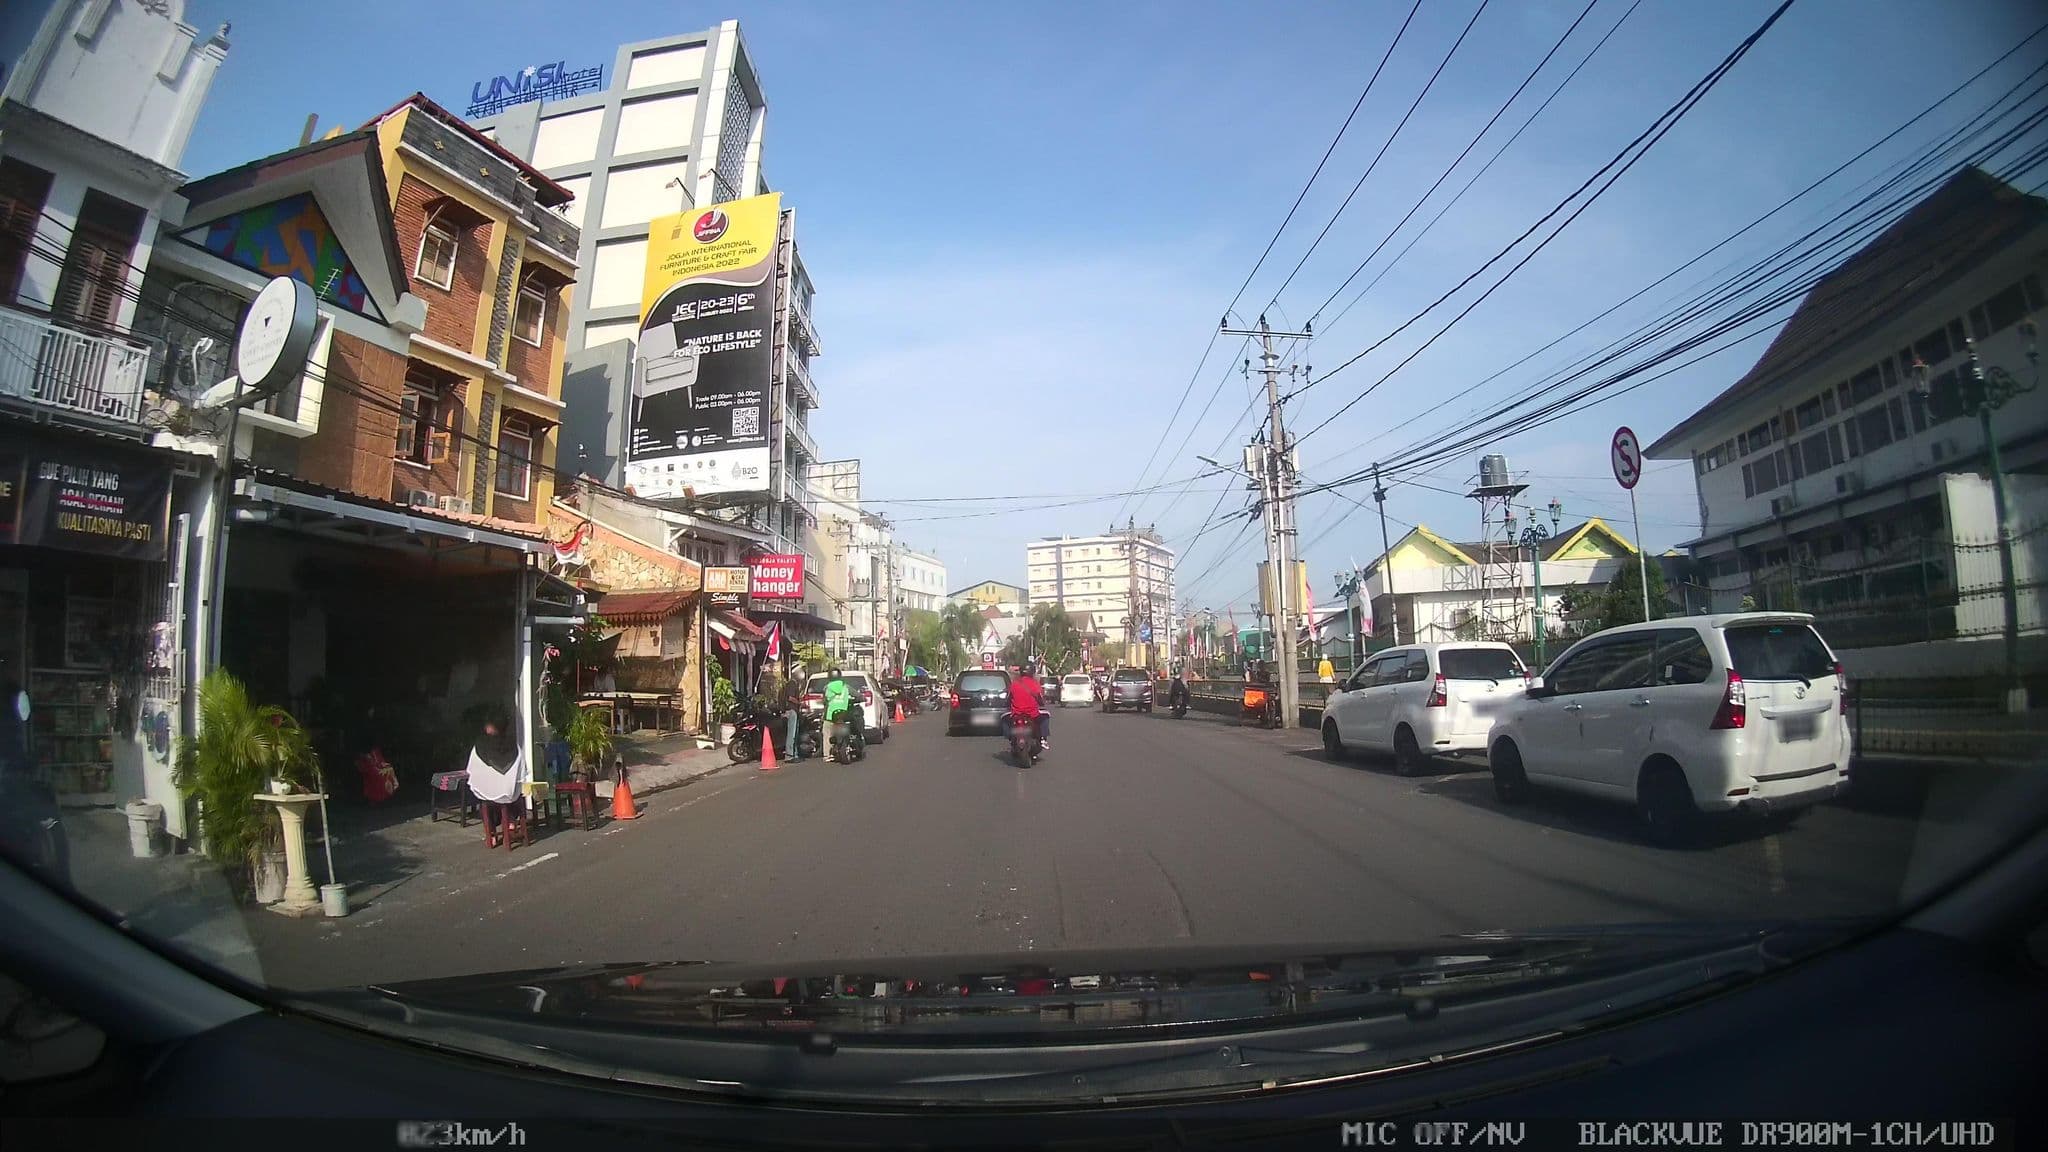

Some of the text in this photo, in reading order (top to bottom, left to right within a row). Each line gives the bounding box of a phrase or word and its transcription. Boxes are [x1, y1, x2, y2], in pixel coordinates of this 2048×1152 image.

[659, 257, 702, 271] FURNITURE
[711, 250, 737, 261] CRAFT
[738, 247, 758, 256] FAIR
[666, 240, 752, 262] JOGJA INTERNATIONAL
[672, 258, 740, 276] INDONESIA 2022
[671, 293, 756, 317] JEC 20-23 6th
[725, 331, 735, 342] IS
[737, 329, 762, 339] BACK
[673, 348, 692, 359] FOR
[693, 345, 711, 356] ECO
[39, 462, 119, 490] GUE PILIH YANG
[57, 511, 151, 542] KUALITASNYA PASTI
[751, 565, 794, 581] Money
[753, 580, 800, 595] hanger
